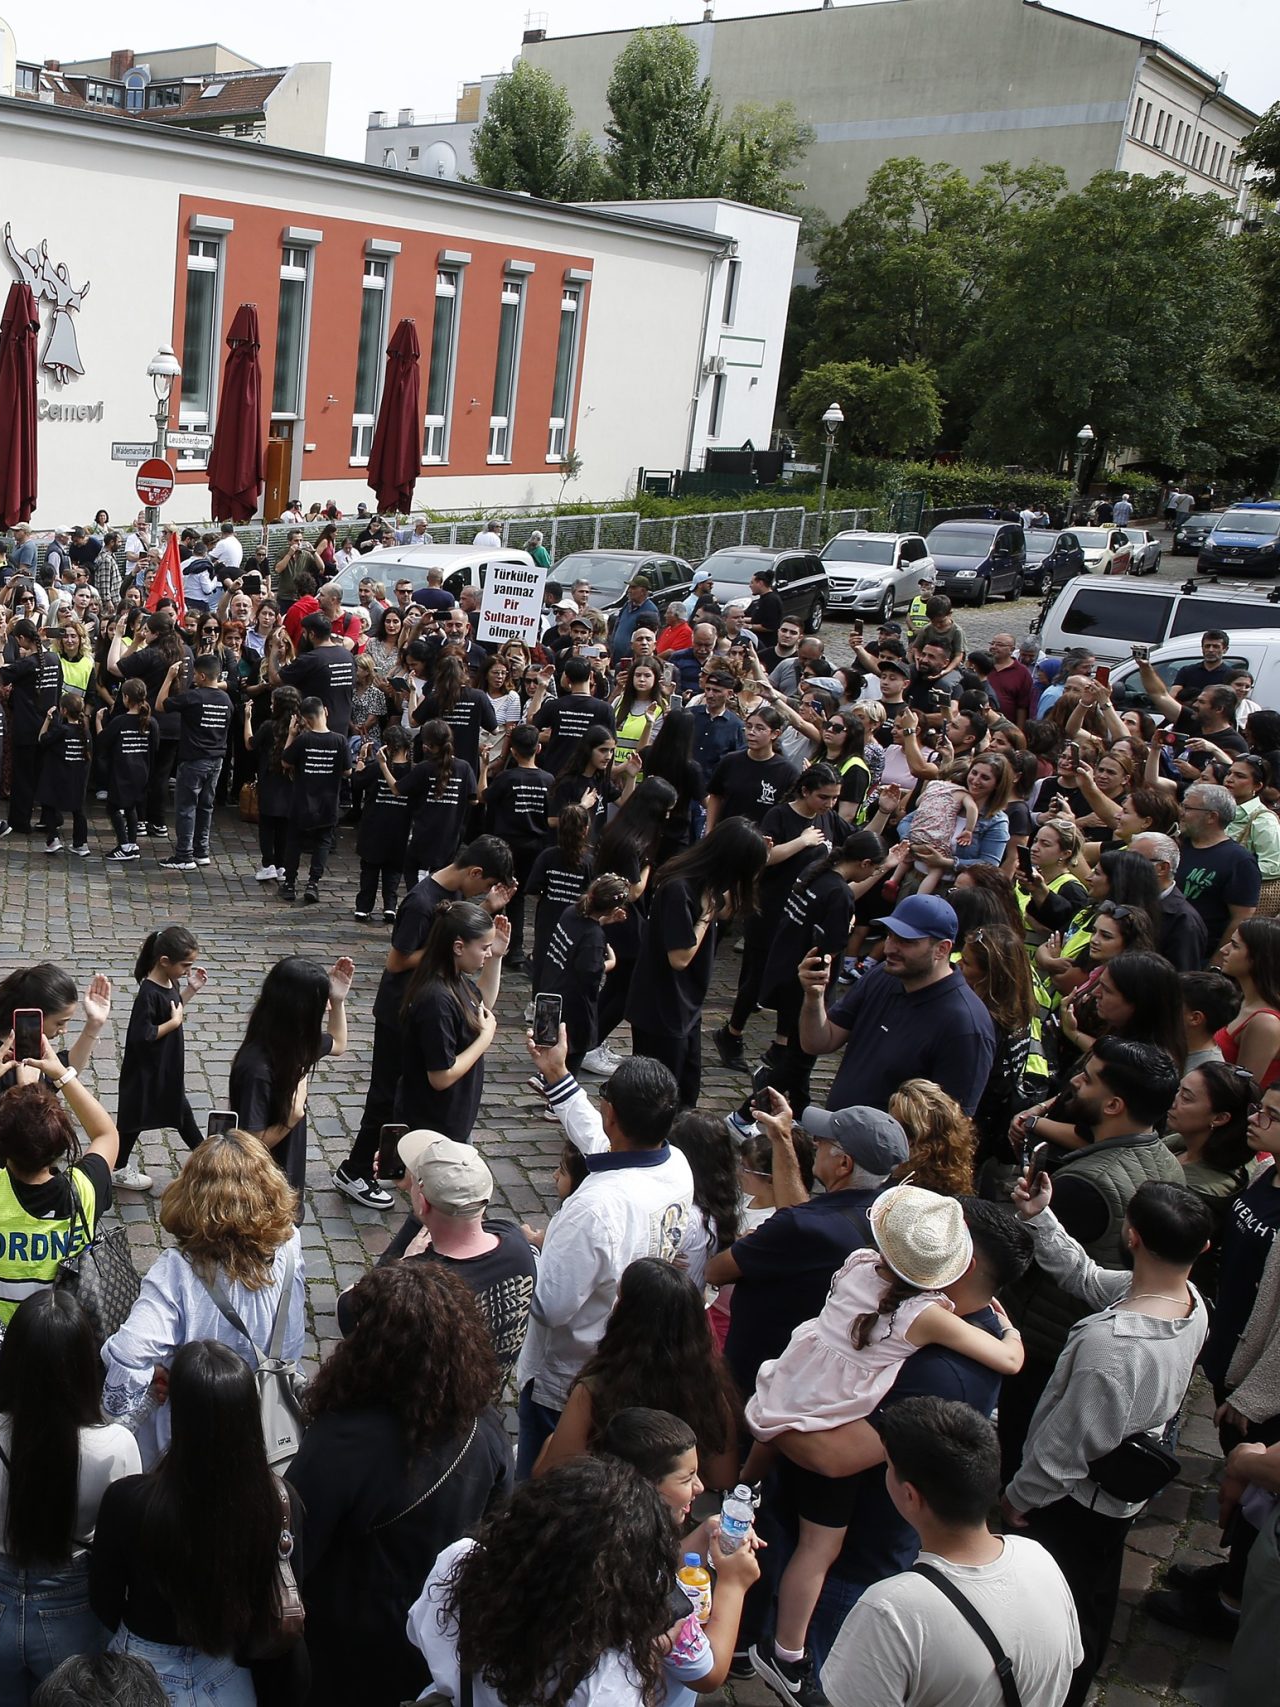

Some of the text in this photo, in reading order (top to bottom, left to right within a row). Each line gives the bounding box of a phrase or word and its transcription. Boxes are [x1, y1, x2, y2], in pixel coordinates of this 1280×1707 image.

[169, 435, 210, 446] Leuschnerdamm
[115, 446, 151, 457] Waldemarstraße
[494, 568, 539, 584] Türküler
[493, 584, 535, 598] yanmaz
[504, 598, 519, 610] Pir
[488, 625, 521, 639] ölmez
